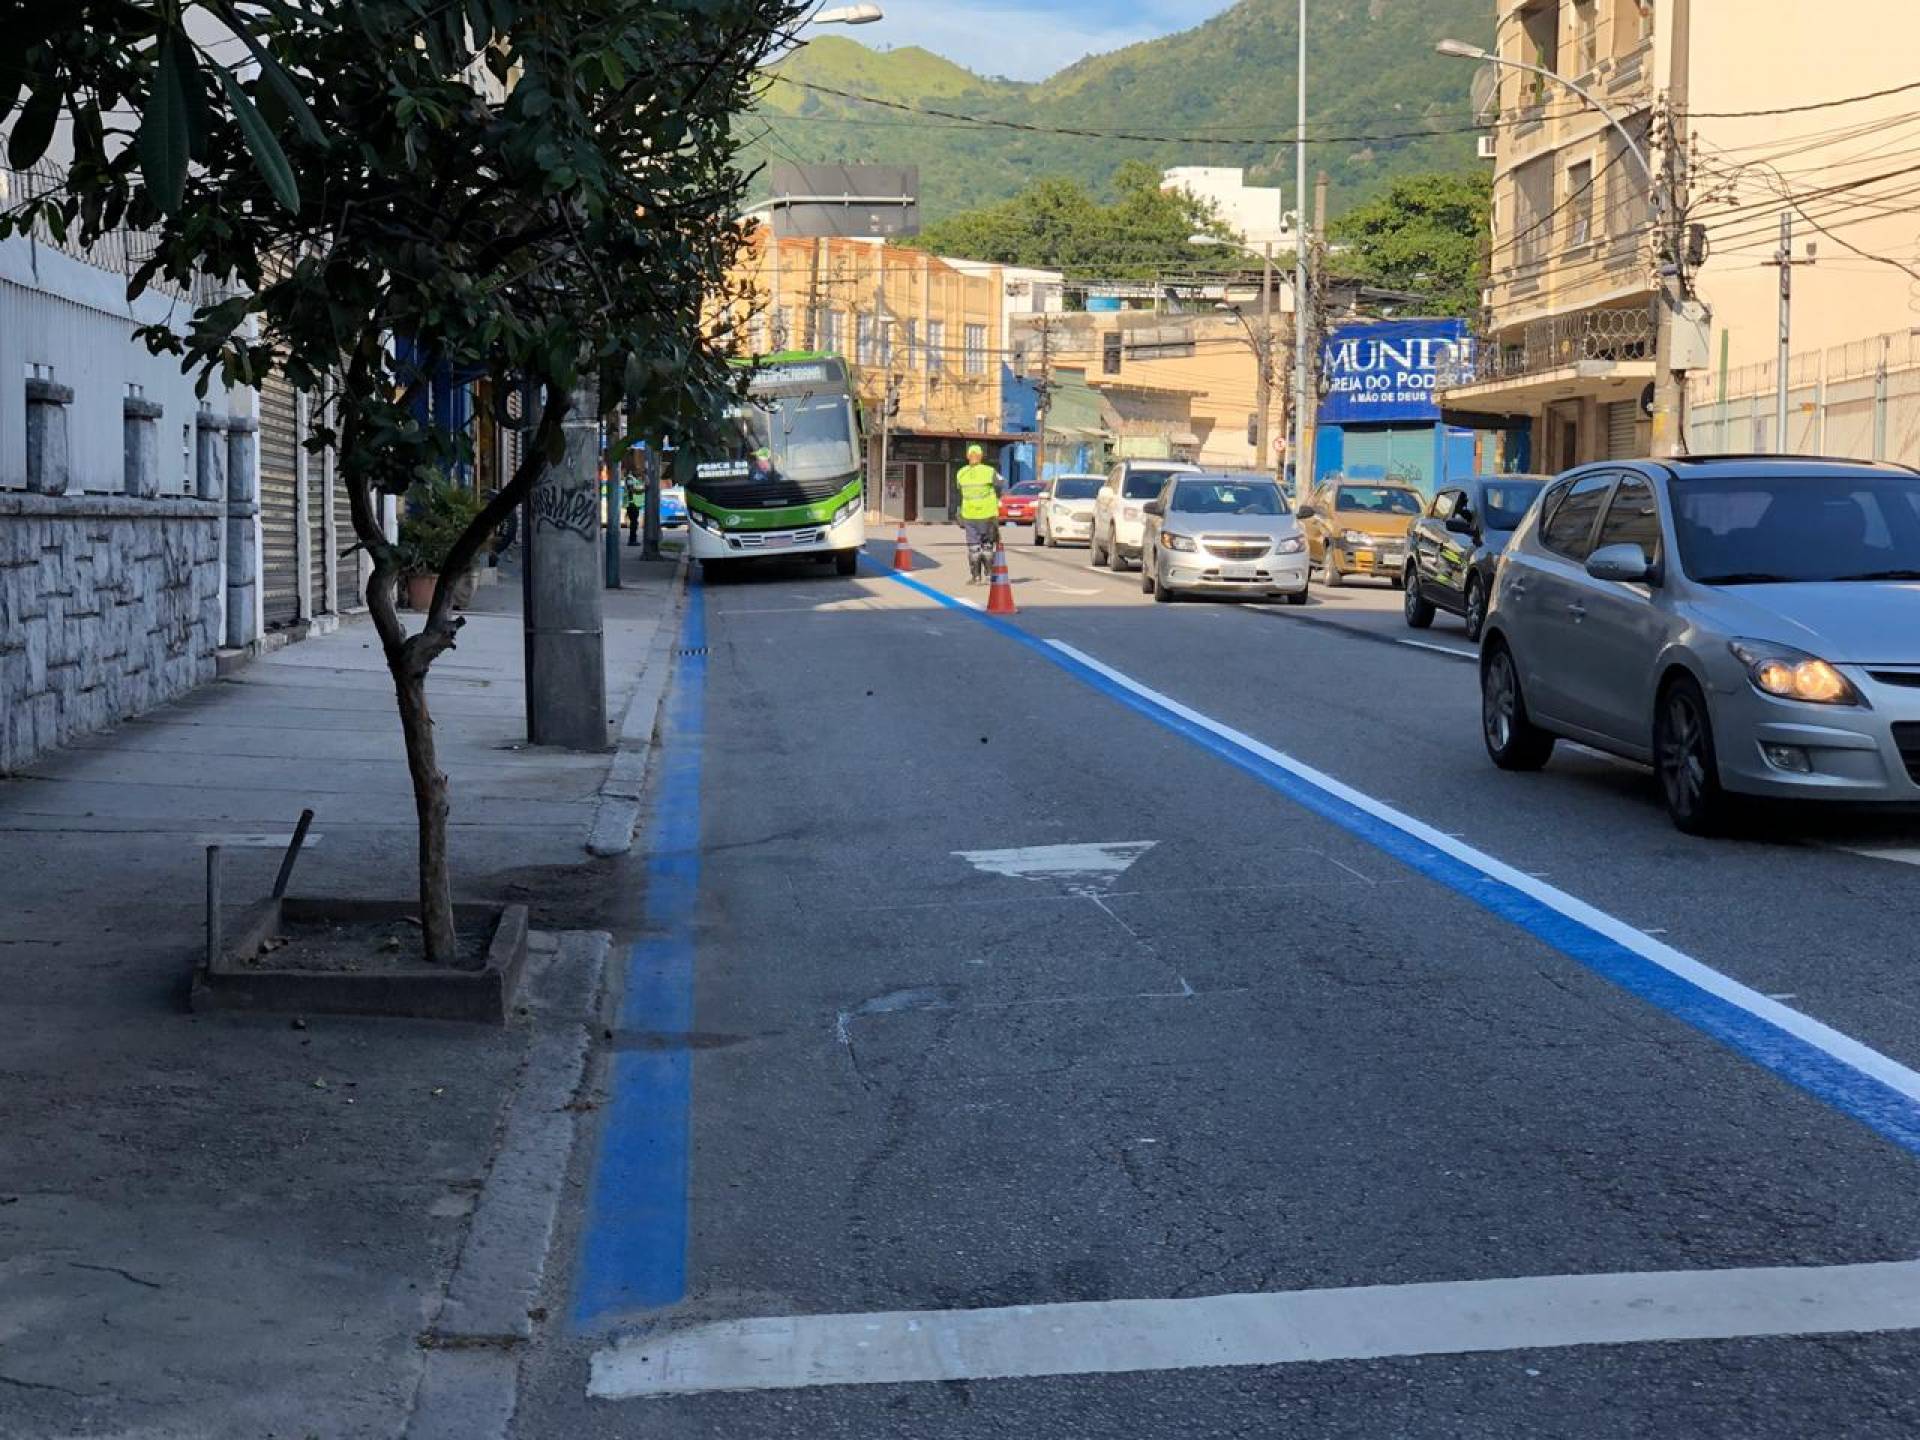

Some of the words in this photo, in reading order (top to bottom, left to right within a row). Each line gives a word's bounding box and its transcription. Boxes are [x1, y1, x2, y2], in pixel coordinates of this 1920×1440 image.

[1365, 374, 1391, 391] DO
[1381, 392, 1395, 402] DE
[1397, 391, 1427, 402] DEUS
